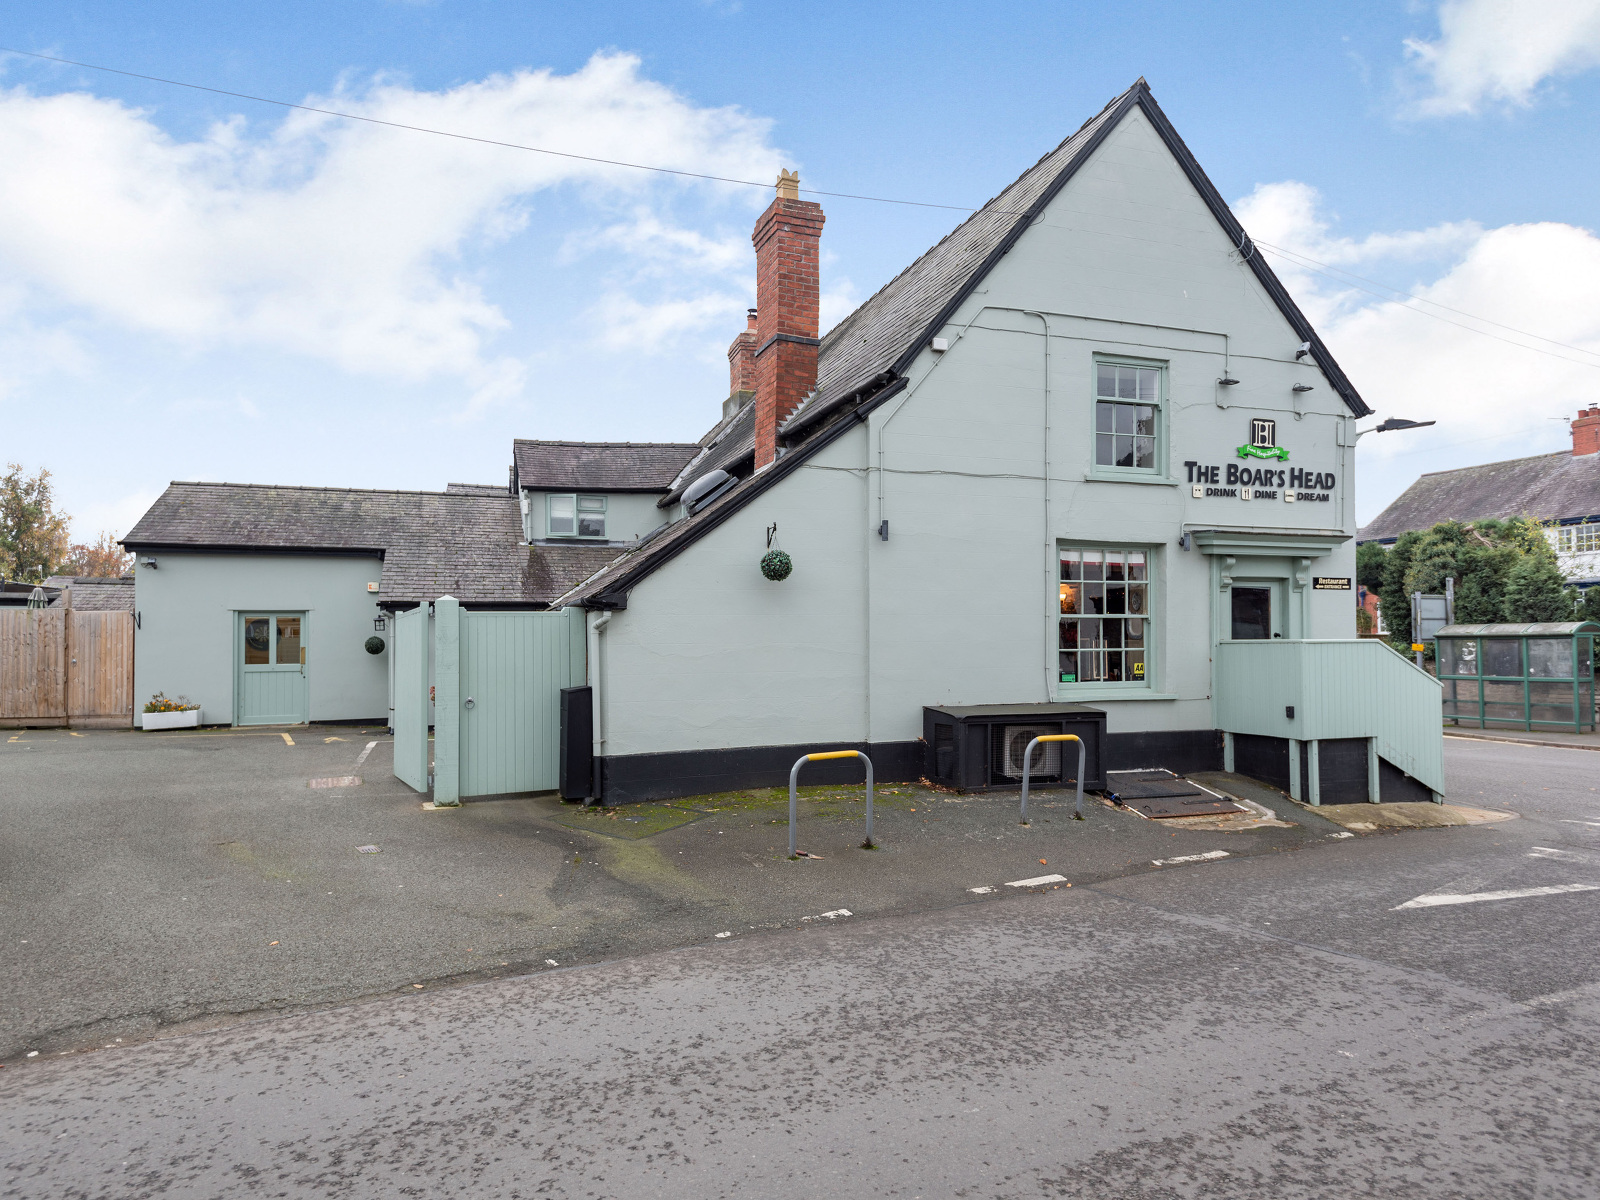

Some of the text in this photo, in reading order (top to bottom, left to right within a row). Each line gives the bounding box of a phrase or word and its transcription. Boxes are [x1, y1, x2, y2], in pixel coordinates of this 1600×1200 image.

[1184, 461, 1335, 490] THE BOAR'S HEAD
[1206, 487, 1237, 498] DRINK
[1254, 489, 1278, 500] DINE
[1296, 491, 1330, 502] DREAM
[1318, 577, 1348, 585] Restaurant
[1136, 664, 1144, 672] AA
